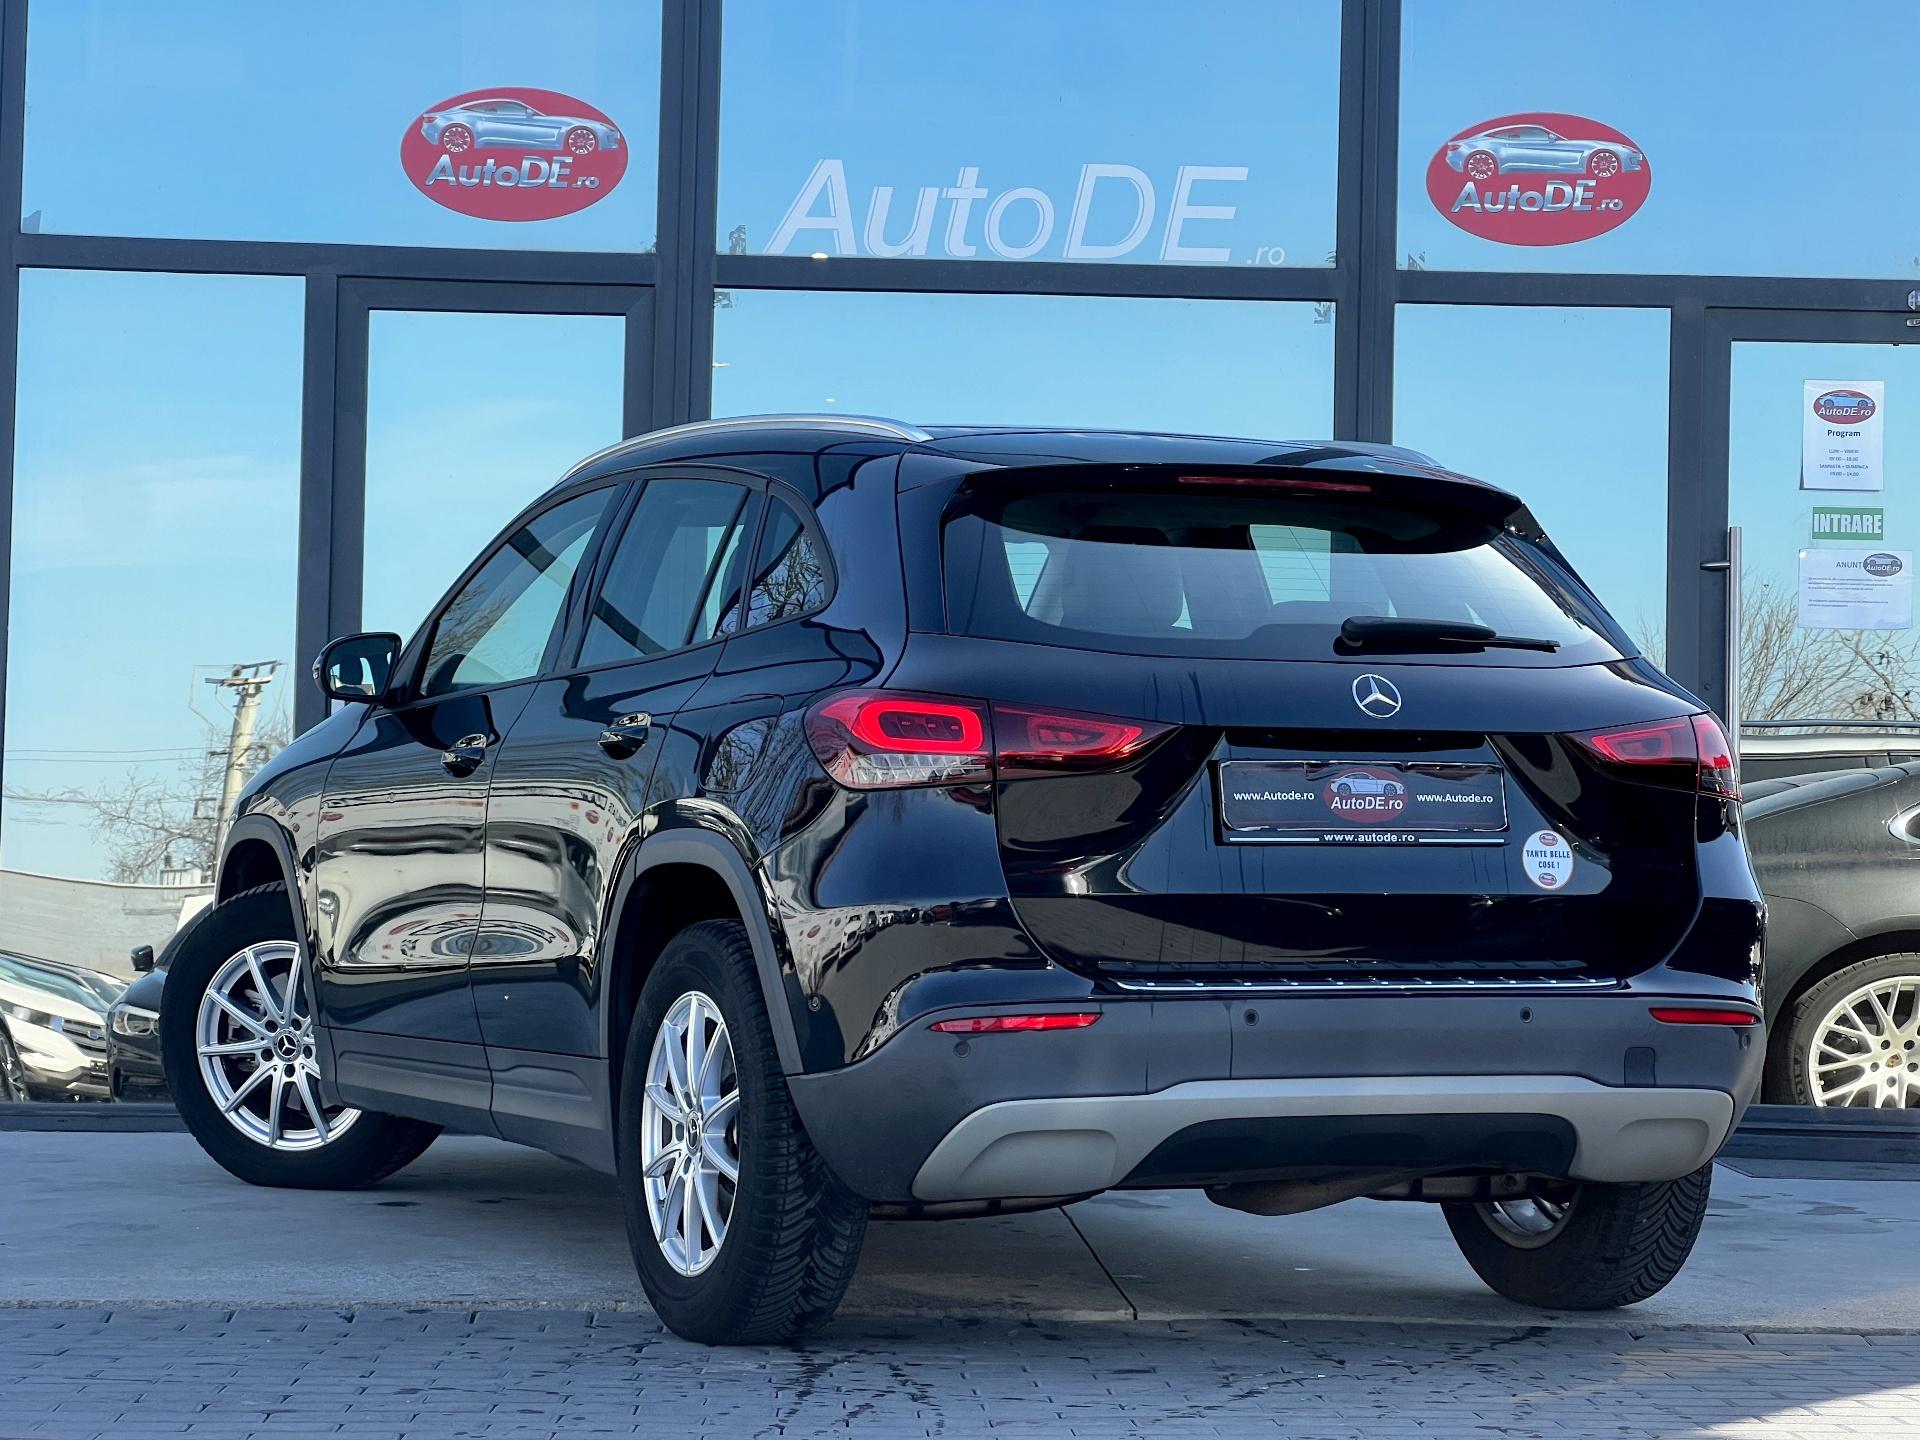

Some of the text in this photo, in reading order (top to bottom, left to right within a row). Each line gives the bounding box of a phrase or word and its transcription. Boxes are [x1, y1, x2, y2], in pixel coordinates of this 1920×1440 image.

[1818, 407, 1872, 417] AutoDE.ro
[1827, 429, 1861, 438] Program
[1813, 513, 1882, 533] INTRARE
[1233, 790, 1315, 801] www.Autode.ro
[1416, 792, 1494, 803] www.Autode.ro
[1330, 796, 1404, 811] AutoDE.ro
[1323, 832, 1416, 843] www.autode.ro
[1526, 849, 1571, 859] TANTE BELLE
